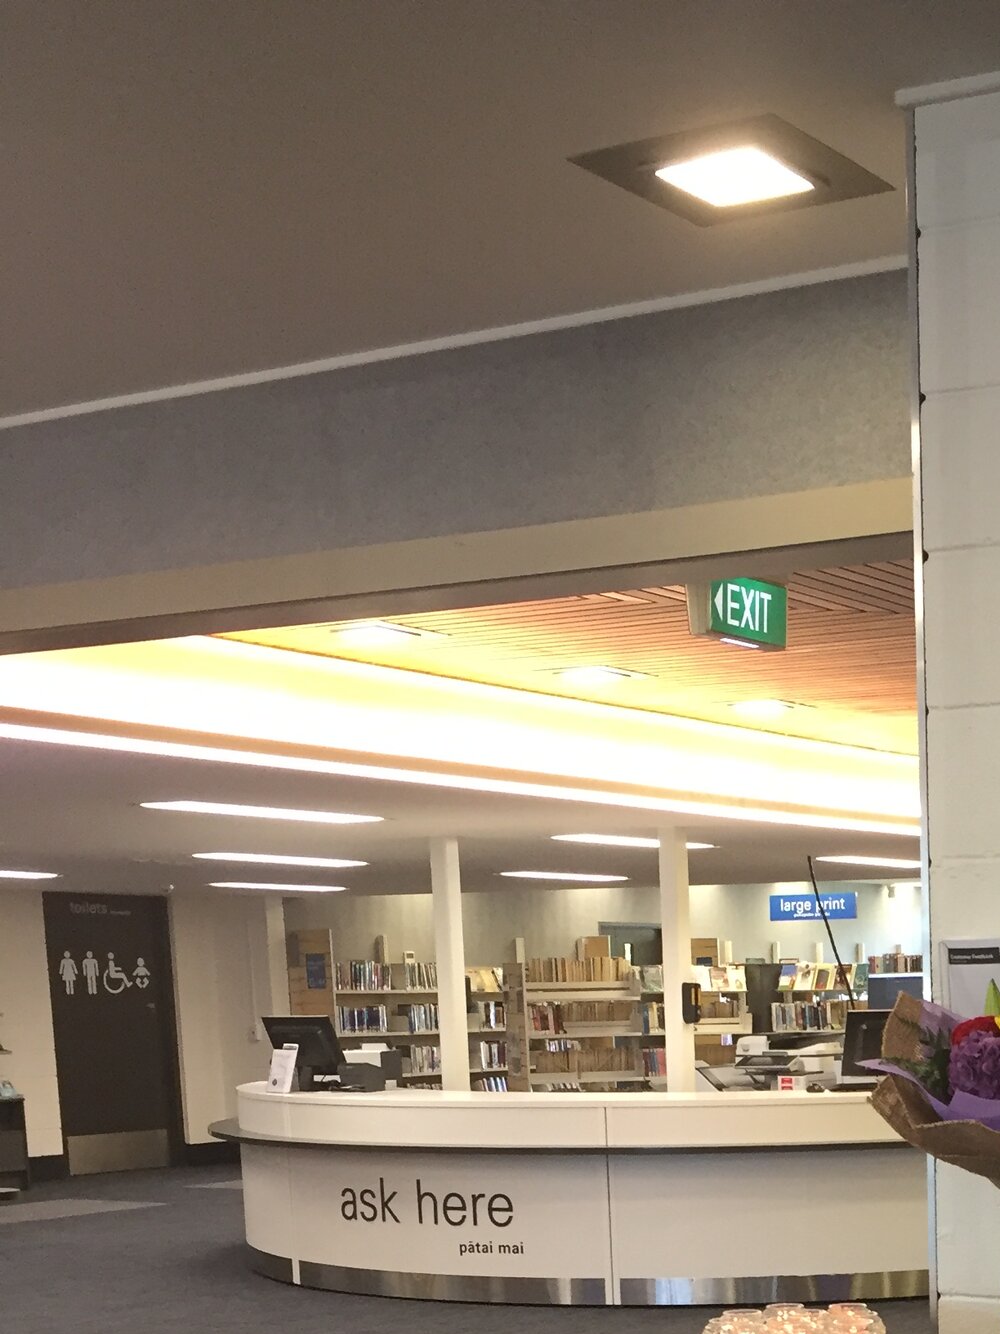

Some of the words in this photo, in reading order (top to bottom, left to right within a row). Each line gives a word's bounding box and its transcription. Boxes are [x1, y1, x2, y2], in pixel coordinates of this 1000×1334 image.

[727, 583, 772, 634] EXIT
[69, 901, 108, 914] toilets
[780, 898, 812, 914] large
[815, 896, 846, 914] print
[341, 1177, 401, 1223] ask
[415, 1178, 514, 1228] here
[459, 1241, 493, 1257] pātai
[498, 1242, 524, 1255] mai
